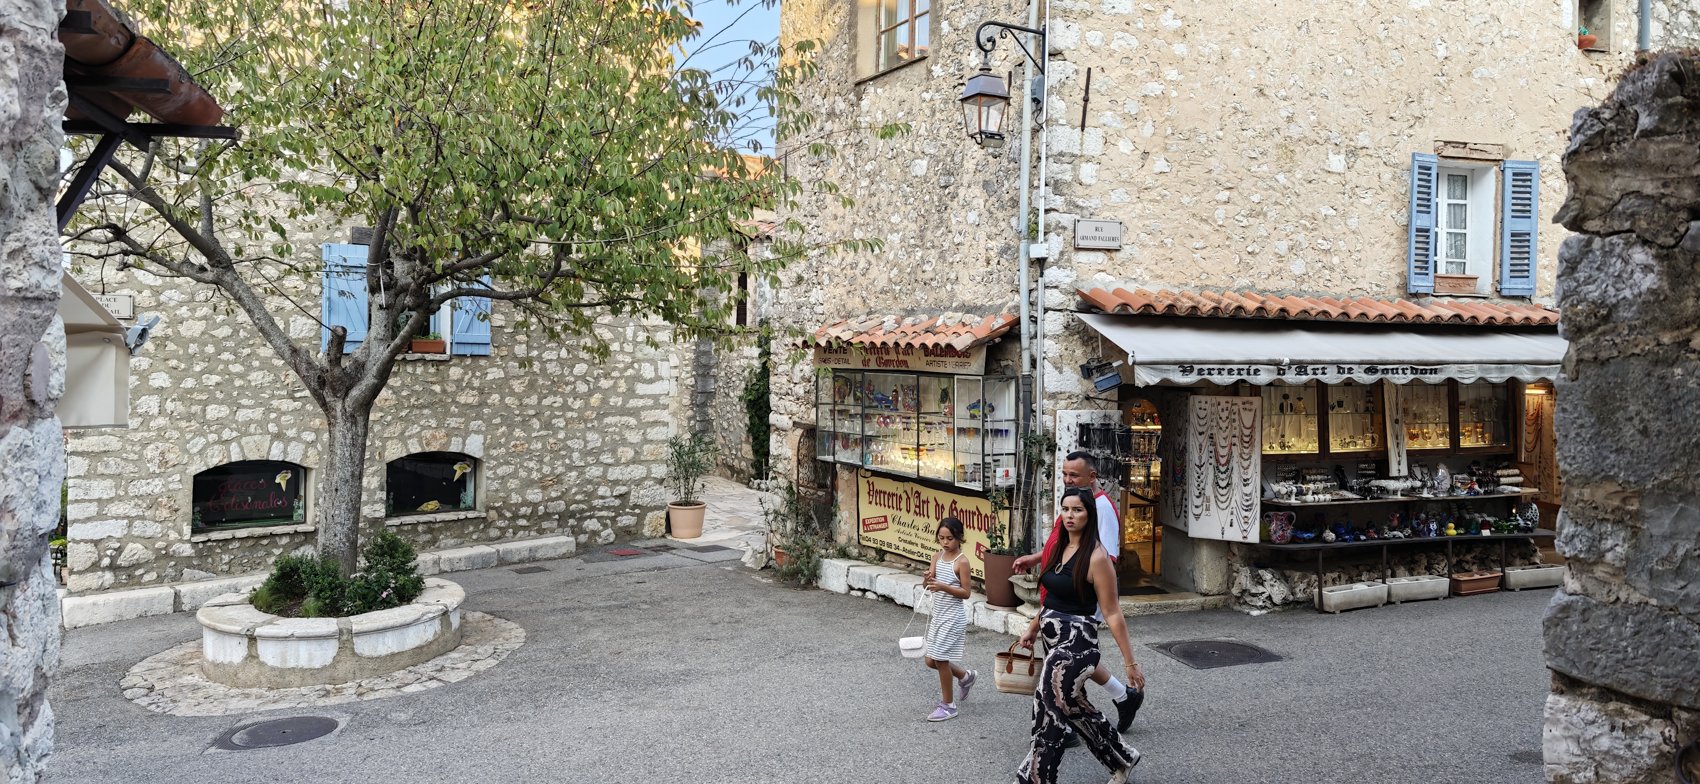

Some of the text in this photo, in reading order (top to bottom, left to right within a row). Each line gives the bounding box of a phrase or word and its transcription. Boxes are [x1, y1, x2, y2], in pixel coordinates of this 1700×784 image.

[823, 346, 848, 354] VENTE
[876, 355, 909, 368] Gourdon
[925, 360, 947, 368] ARTISTE
[1178, 365, 1438, 376] Verrerie d'Art de Gourdon
[867, 480, 902, 511] Verrerie
[903, 486, 930, 519] d'Art
[934, 496, 945, 521] de
[949, 499, 997, 533] Gourdon
[891, 513, 919, 531] Charles
